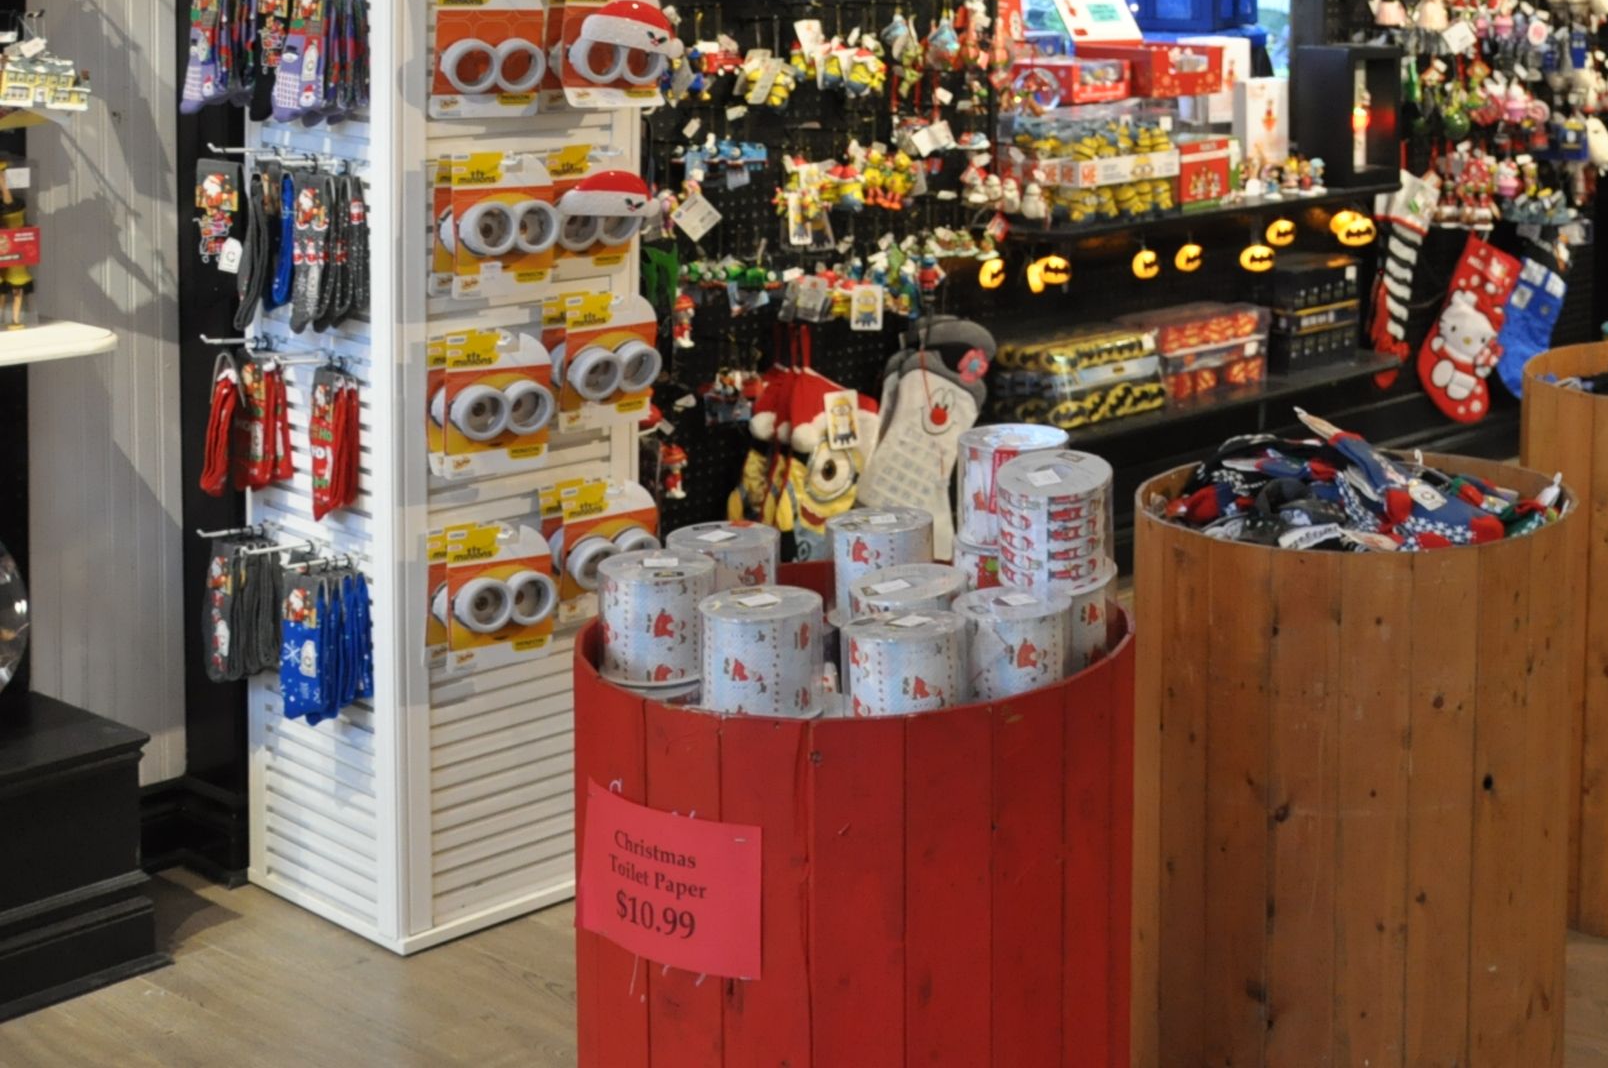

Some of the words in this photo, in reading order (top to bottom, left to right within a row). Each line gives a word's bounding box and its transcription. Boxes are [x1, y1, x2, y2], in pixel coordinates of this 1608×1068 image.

[614, 830, 696, 869] Christmas
[609, 854, 649, 887] Toilet
[654, 872, 707, 901] Paper
[616, 889, 696, 940] $10.99
